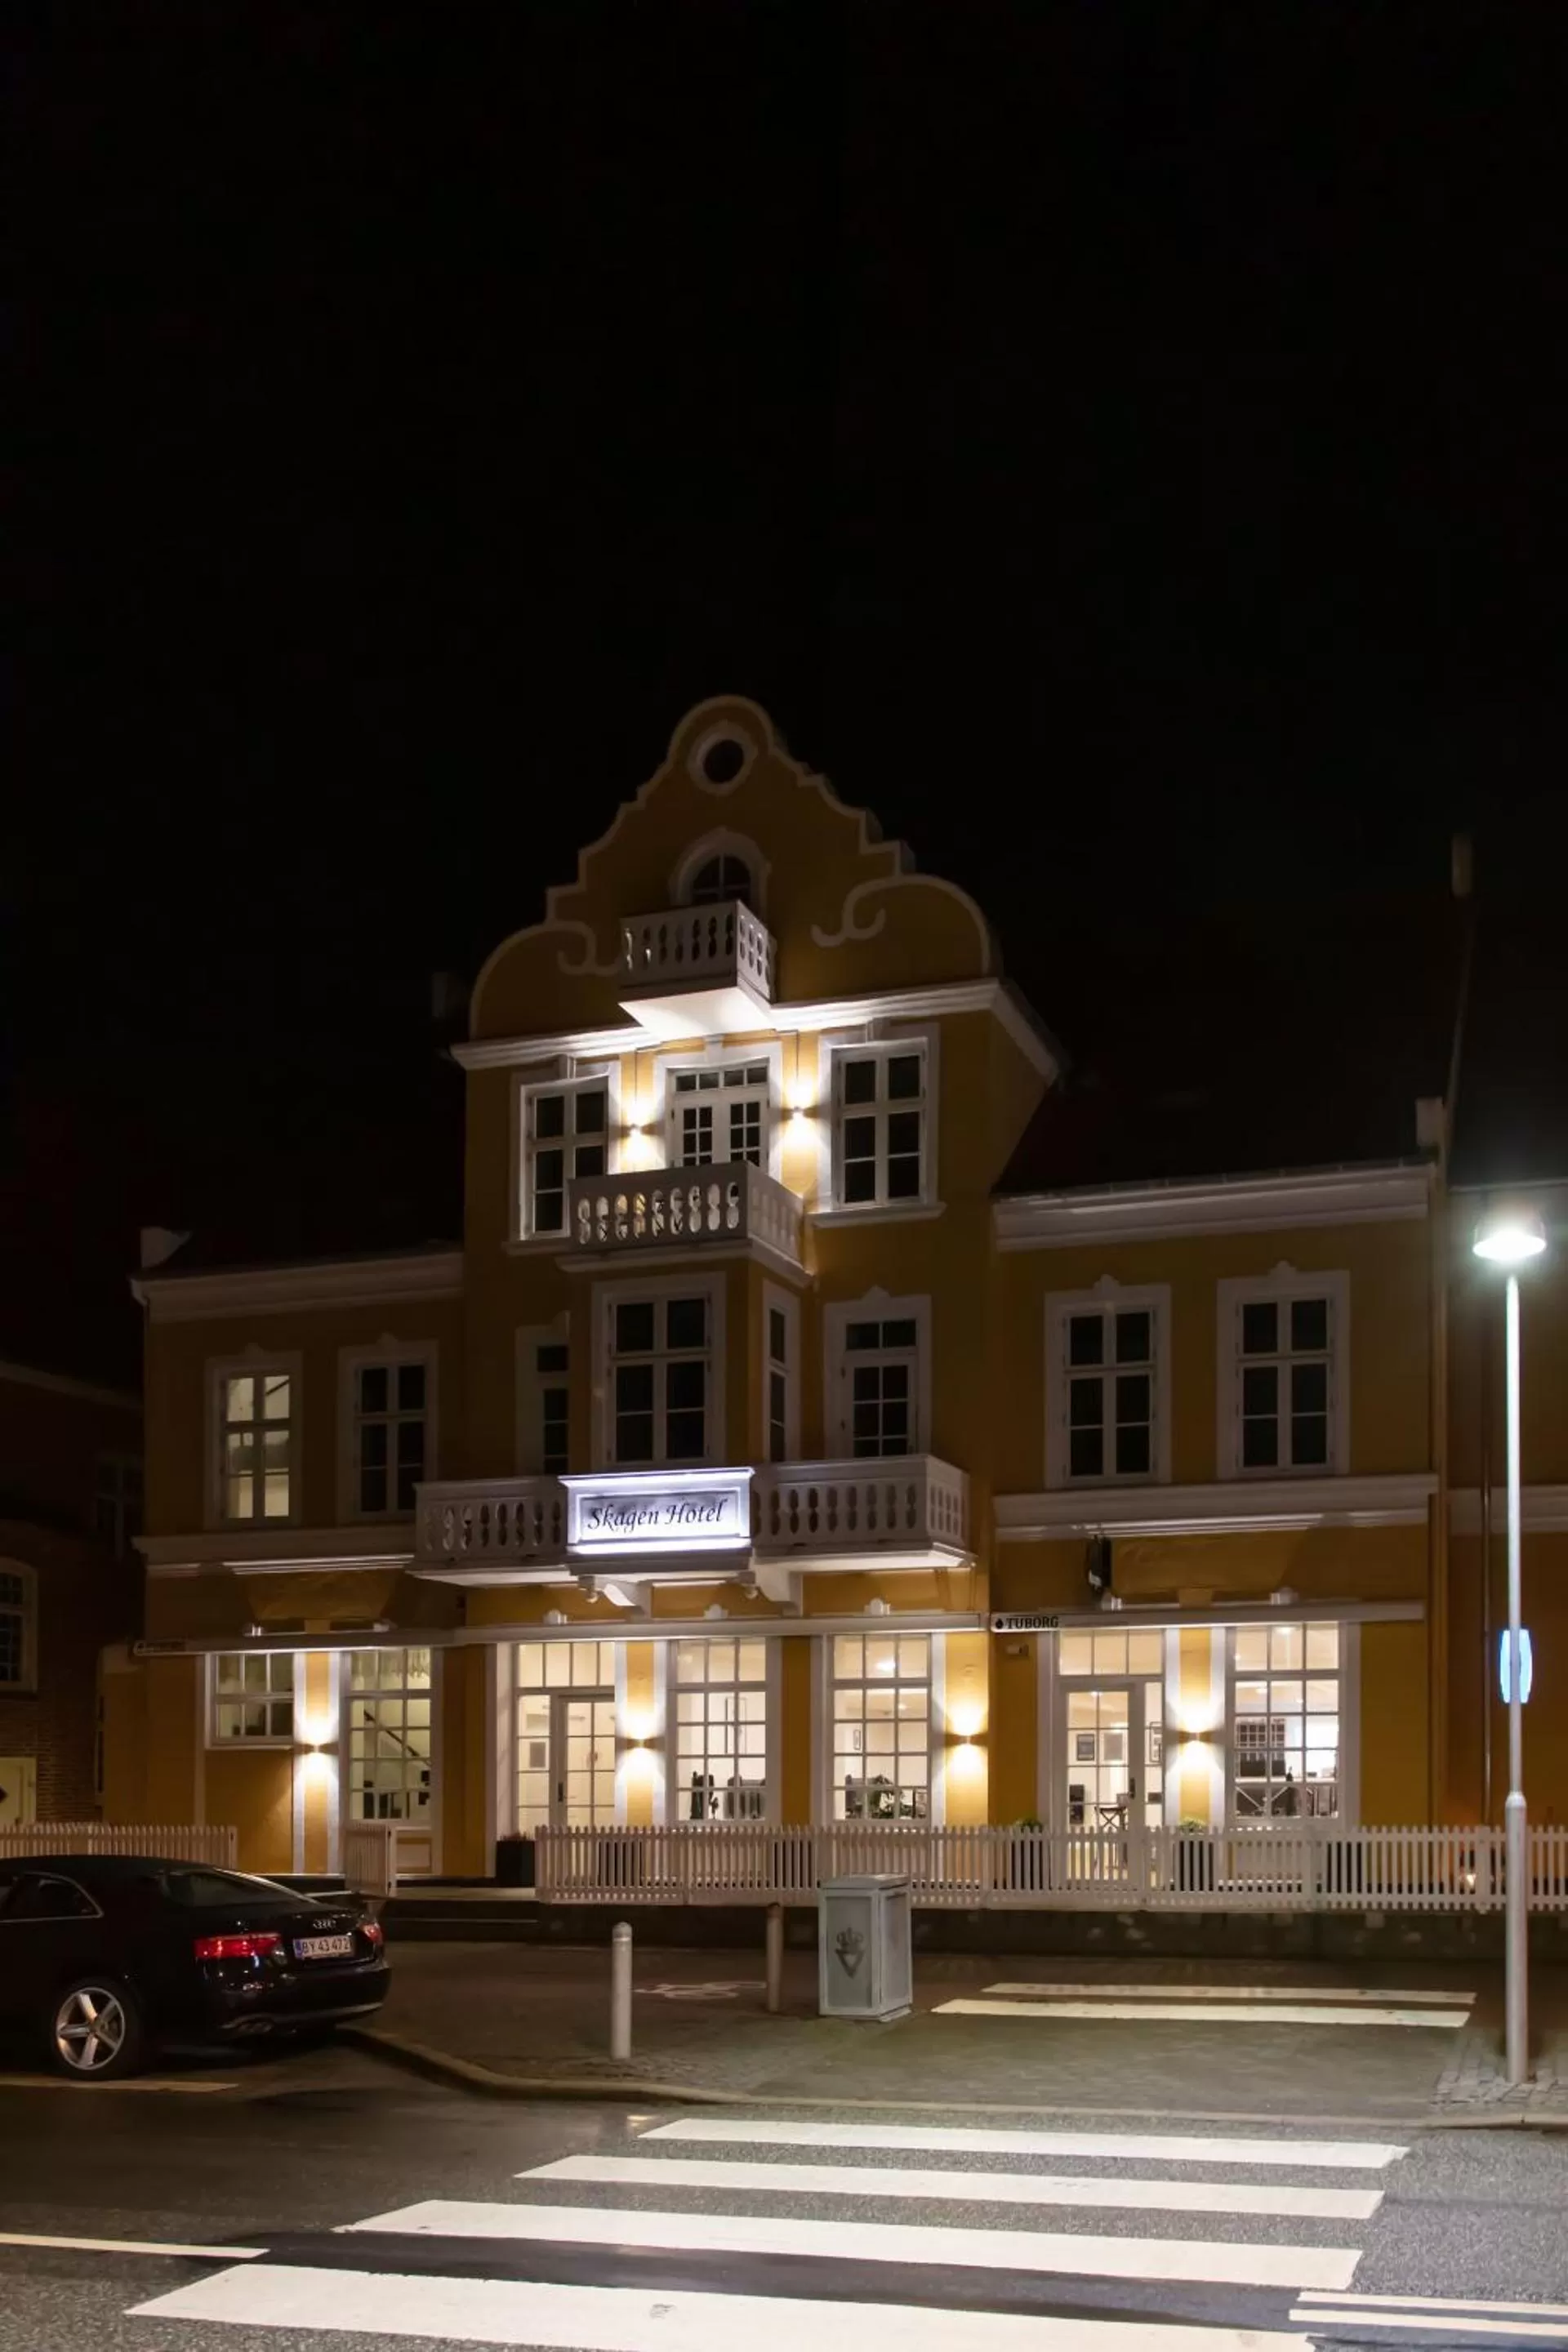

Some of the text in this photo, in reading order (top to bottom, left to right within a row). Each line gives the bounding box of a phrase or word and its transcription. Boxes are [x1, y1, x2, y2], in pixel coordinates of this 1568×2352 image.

[587, 1498, 728, 1533] Skagen Hotel
[1006, 1616, 1059, 1629] TUBORG
